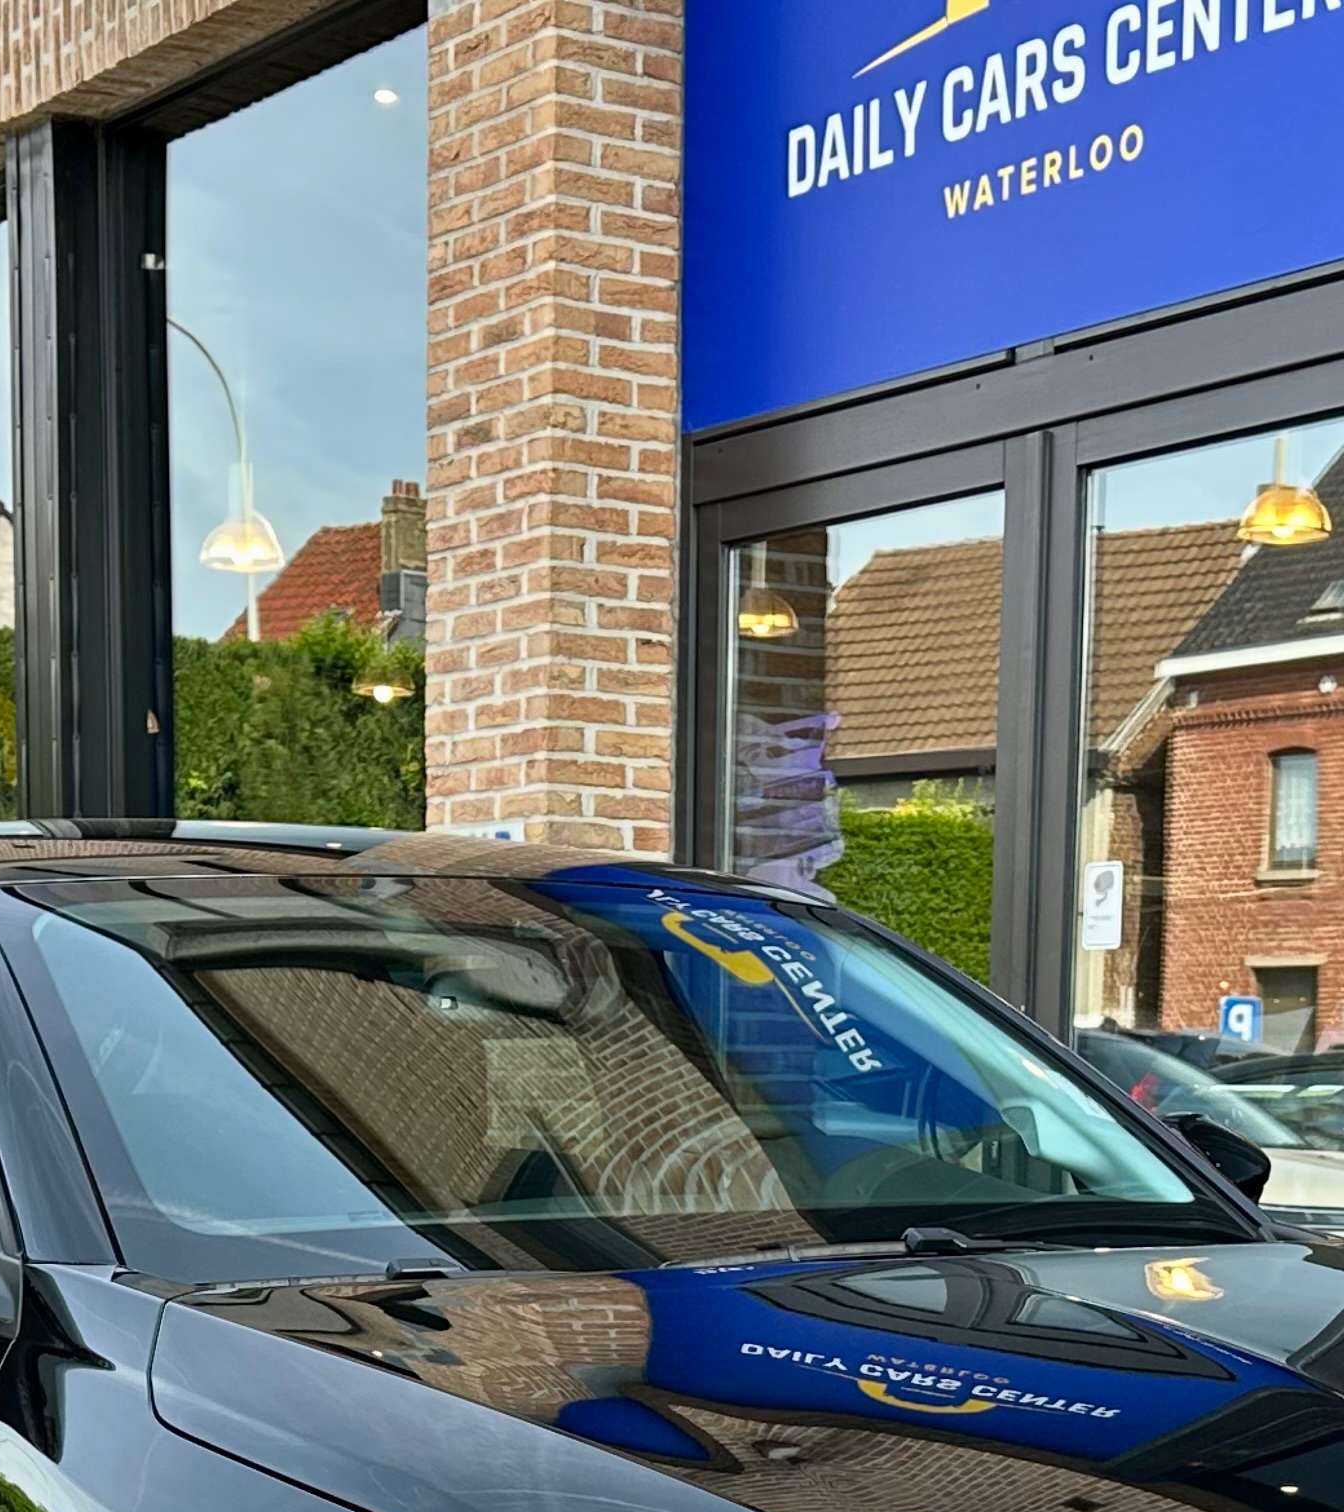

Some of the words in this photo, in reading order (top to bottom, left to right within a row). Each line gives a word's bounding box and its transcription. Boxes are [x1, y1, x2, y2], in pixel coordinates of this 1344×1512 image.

[787, 80, 927, 198] DAILY
[942, 22, 1086, 143] CARS
[943, 123, 1146, 220] WATERLOO
